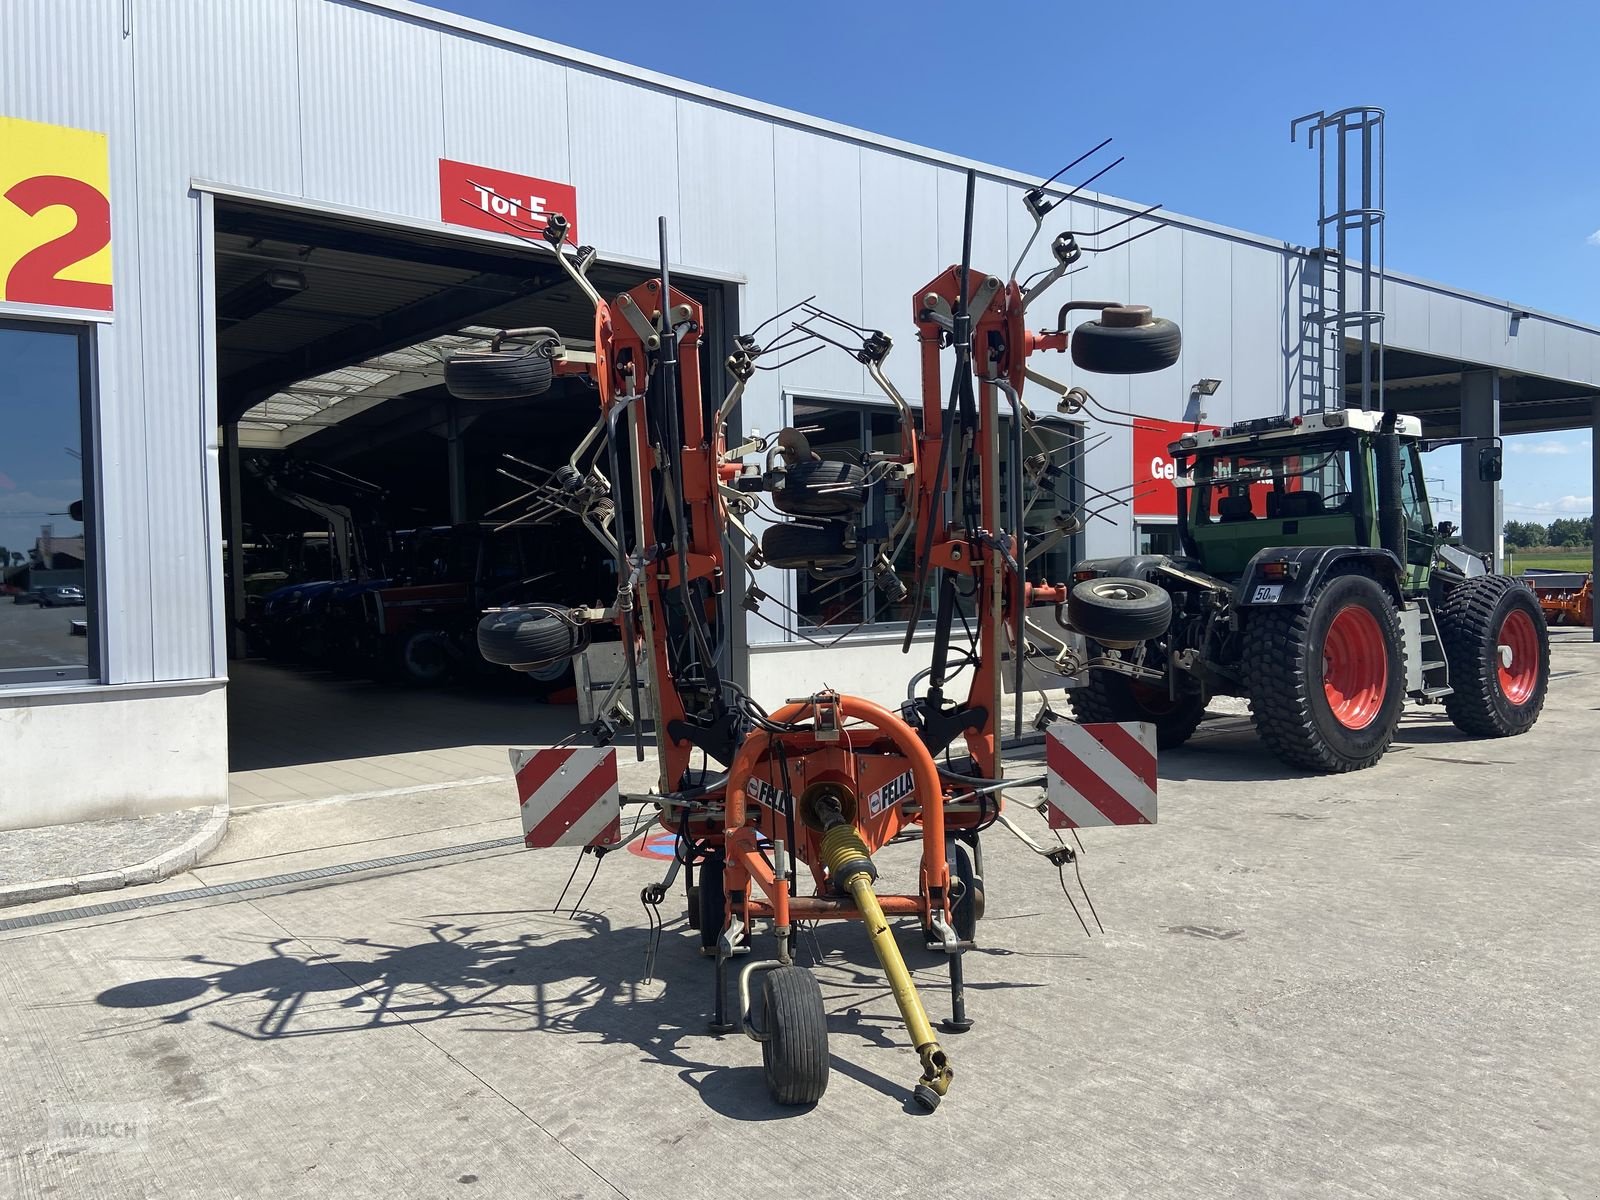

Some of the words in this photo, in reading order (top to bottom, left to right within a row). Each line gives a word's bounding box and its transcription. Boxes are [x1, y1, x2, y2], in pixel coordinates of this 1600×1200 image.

[474, 185, 522, 217] Tor
[530, 195, 549, 223] E
[3, 175, 113, 311] 2
[759, 781, 787, 814] FELL
[882, 771, 914, 809] FELLA
